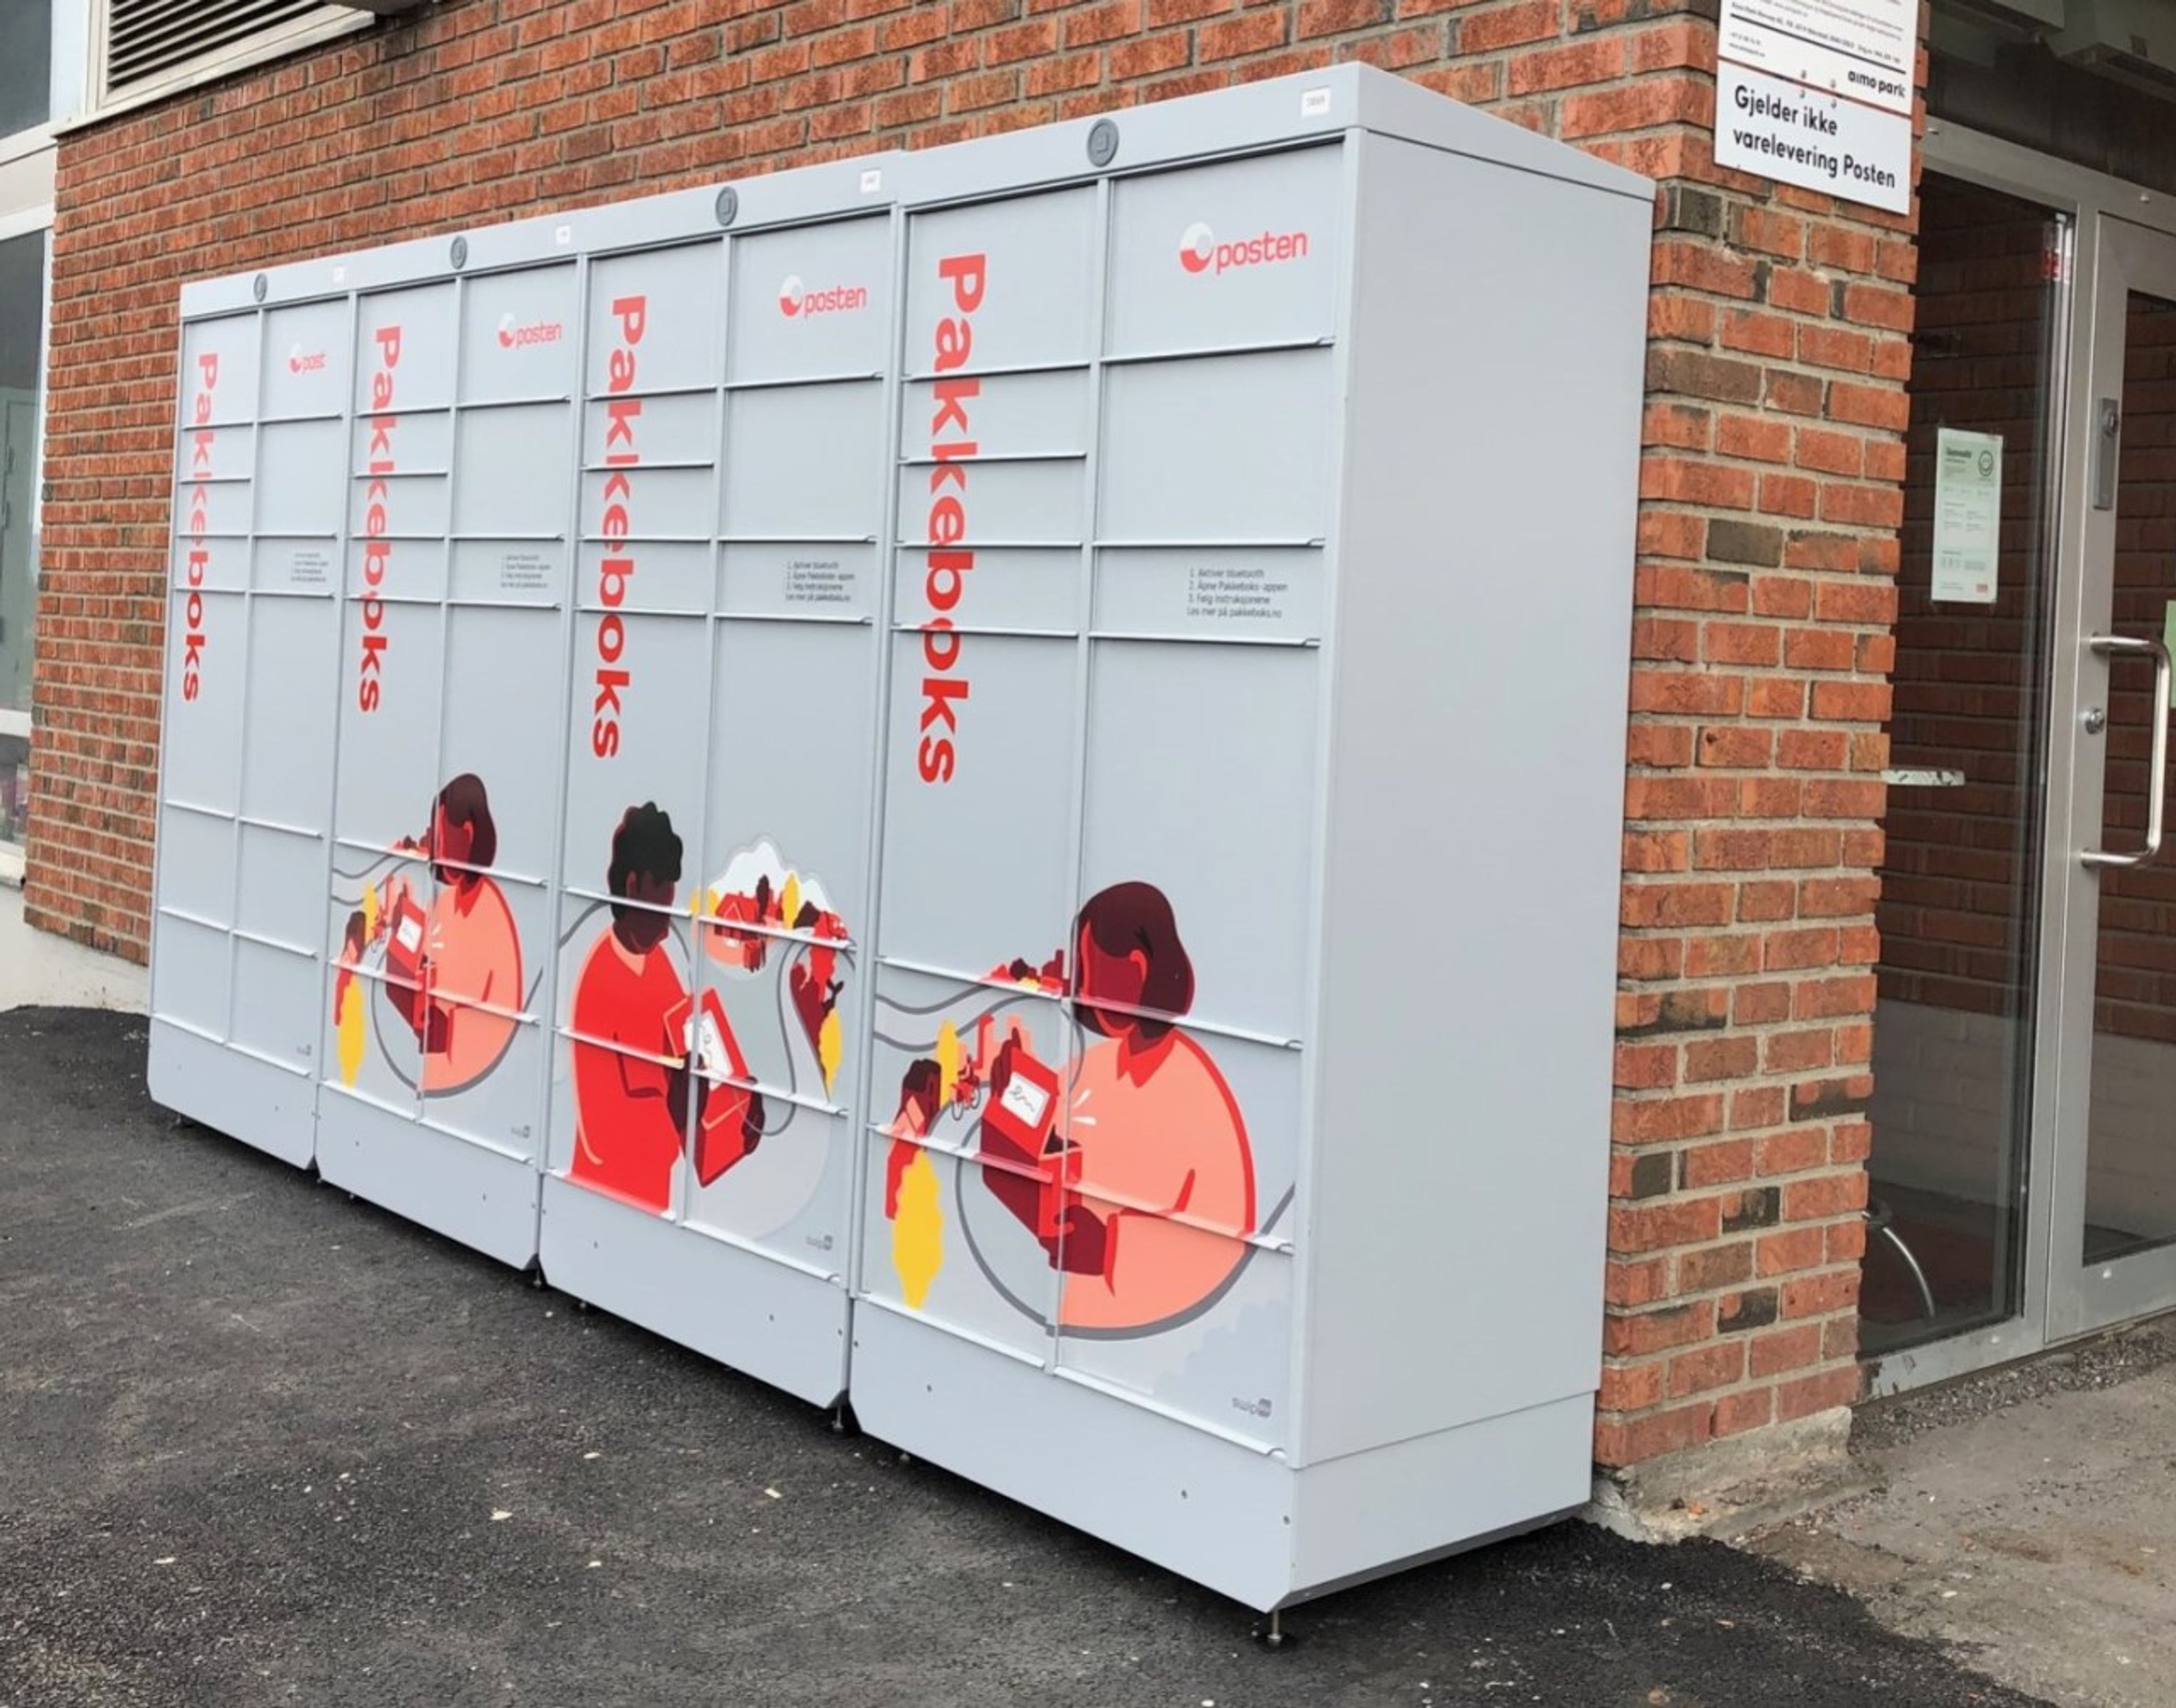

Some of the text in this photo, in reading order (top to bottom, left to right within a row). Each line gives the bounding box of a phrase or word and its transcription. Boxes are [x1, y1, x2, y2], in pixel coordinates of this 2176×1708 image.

[1734, 84, 1838, 136] Gjelder ikke
[1848, 71, 1906, 97] aimo park
[1733, 129, 1896, 189] varelevering Posten
[1216, 231, 1307, 275] posten
[805, 285, 866, 319] posten
[516, 320, 562, 350] posten
[183, 352, 218, 702] Pakkeboks
[359, 326, 401, 712] Pakkeboks
[592, 295, 646, 758] Pakkeboks
[917, 253, 986, 783] Pakkeboks
